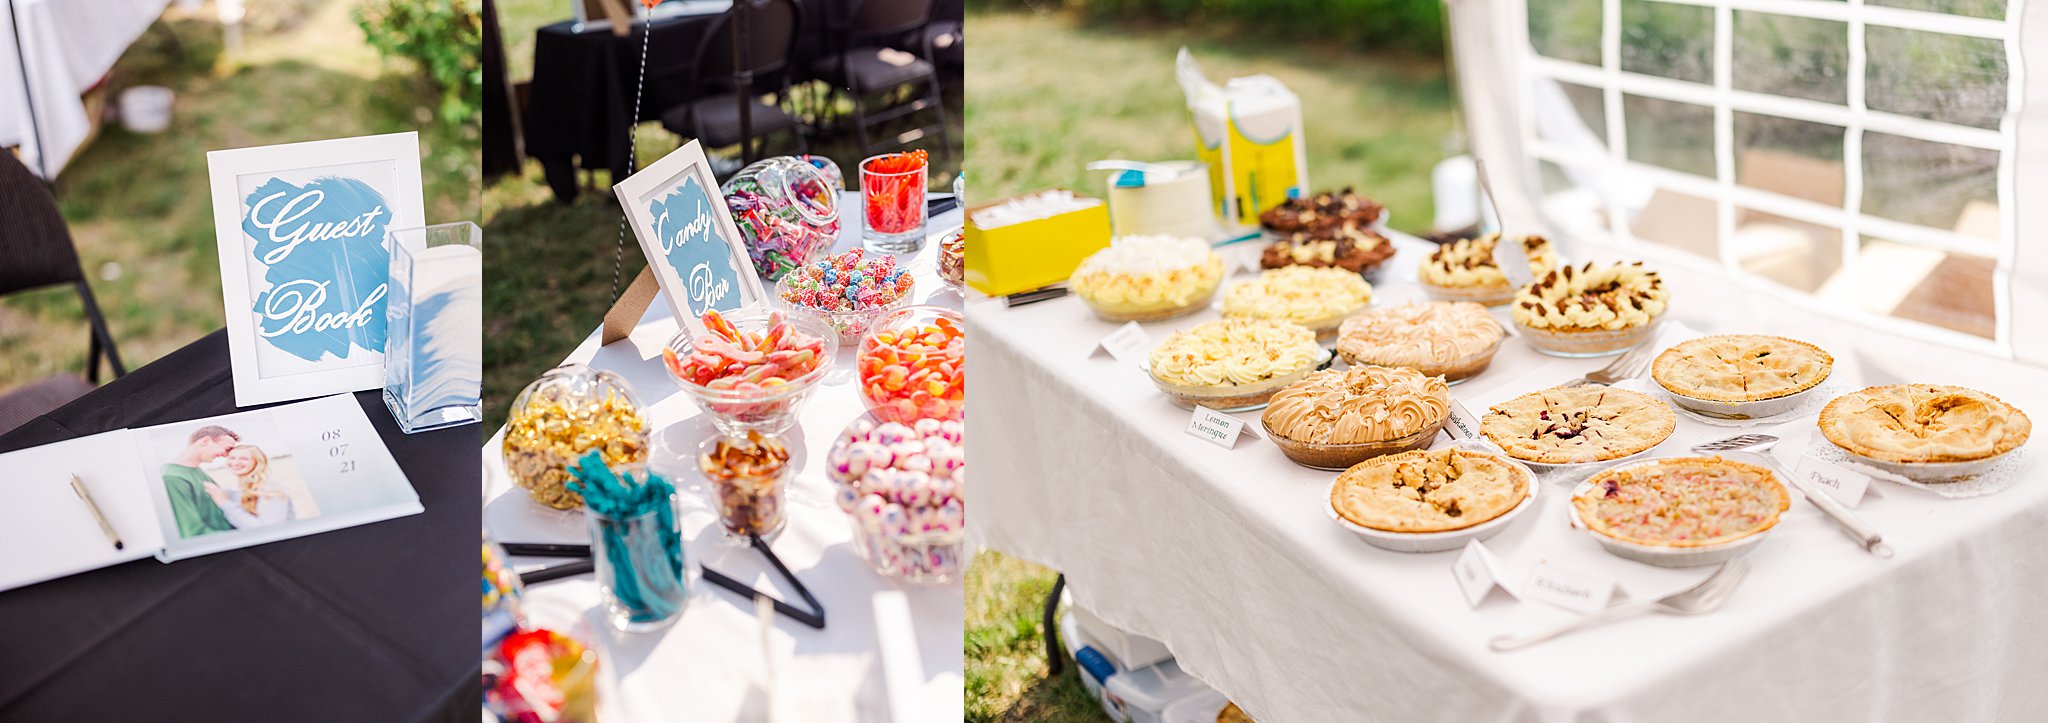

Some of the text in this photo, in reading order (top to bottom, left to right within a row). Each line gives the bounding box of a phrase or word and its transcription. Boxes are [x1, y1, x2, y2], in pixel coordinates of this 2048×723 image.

[251, 189, 384, 265] Guest
[657, 199, 712, 256] Candy
[689, 260, 729, 317] Bar
[258, 279, 388, 337] Book
[1191, 420, 1228, 440] Meringue
[1204, 413, 1230, 429] Lemon
[321, 429, 341, 442] 08
[329, 443, 349, 457] 07
[340, 460, 356, 473] 21
[1809, 470, 1840, 490] Peach
